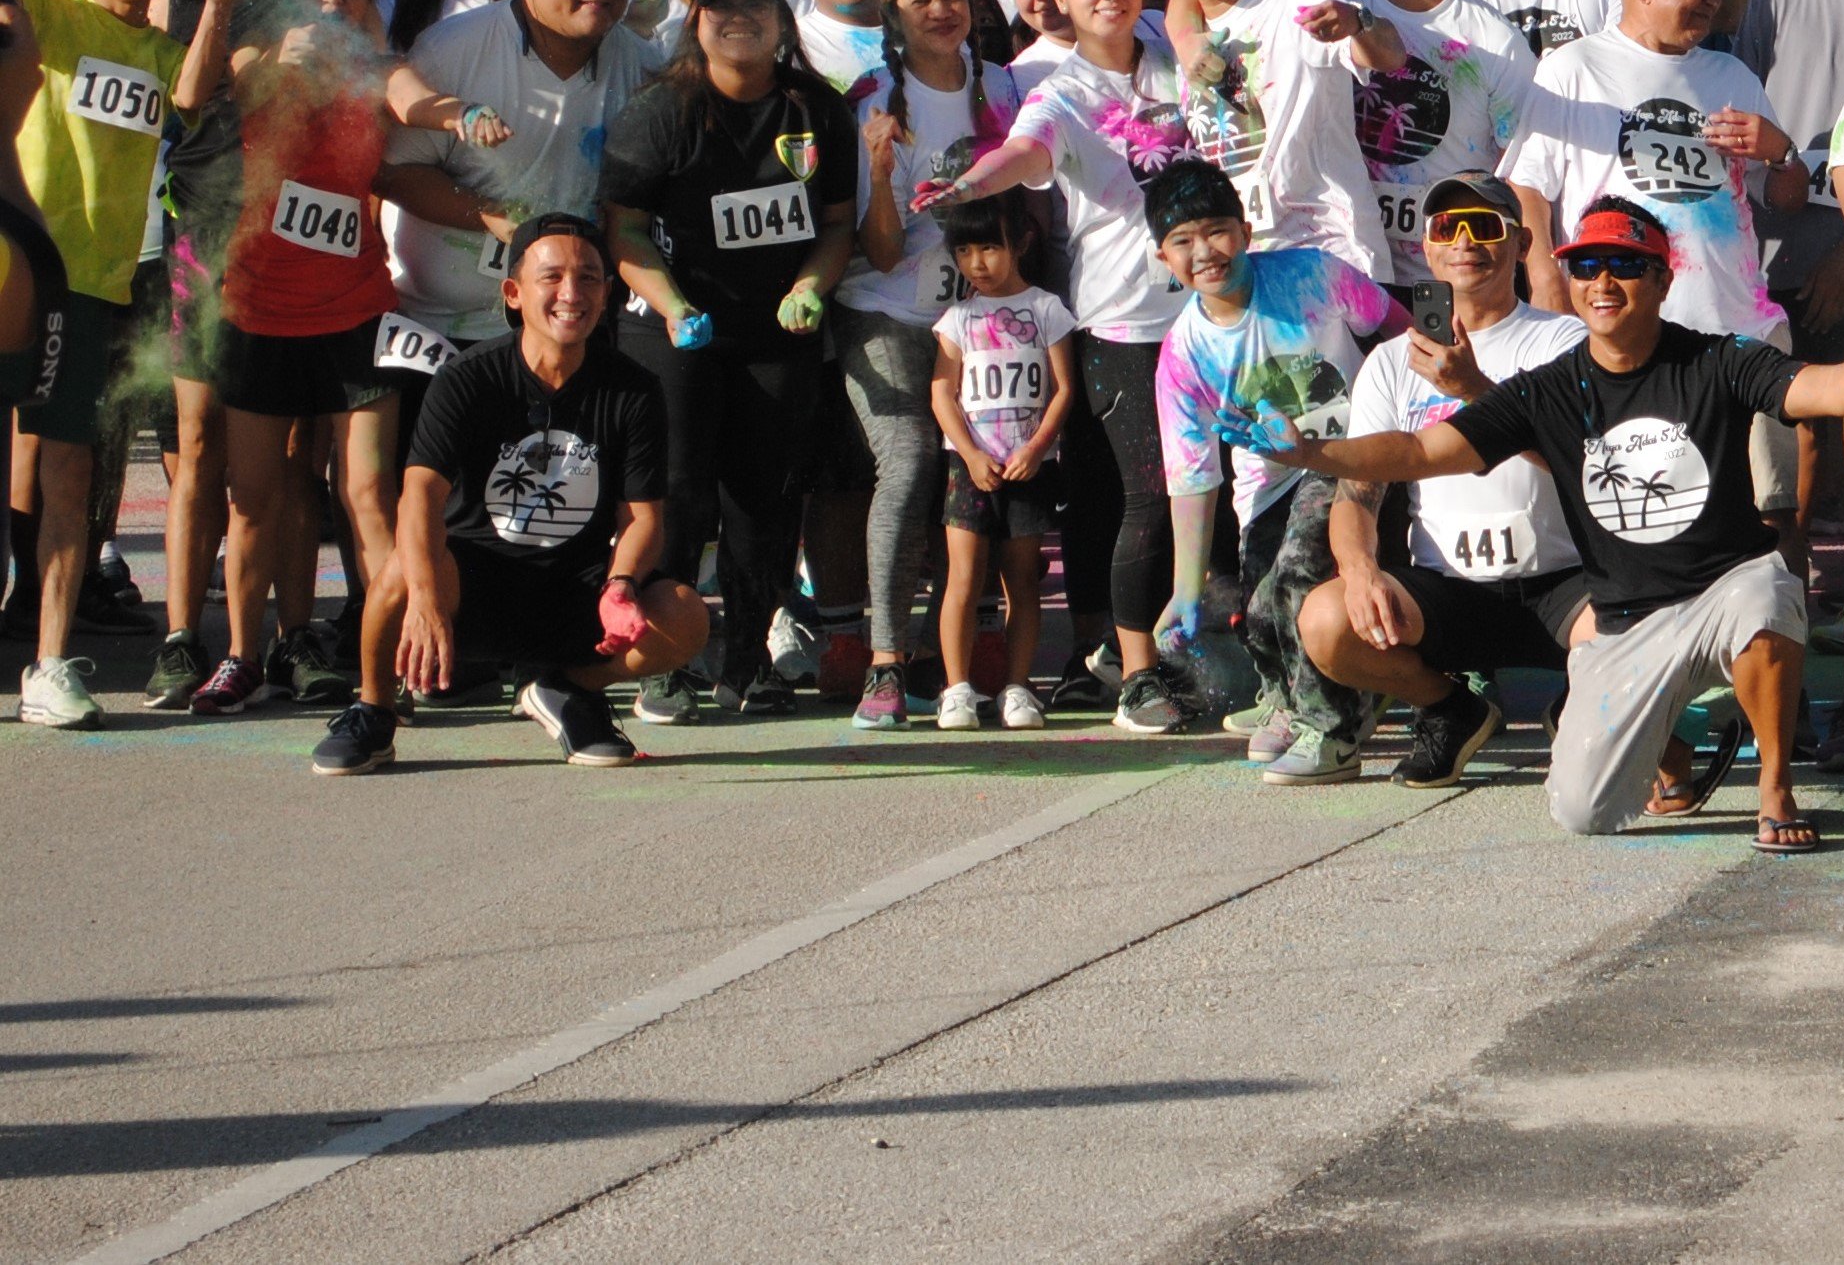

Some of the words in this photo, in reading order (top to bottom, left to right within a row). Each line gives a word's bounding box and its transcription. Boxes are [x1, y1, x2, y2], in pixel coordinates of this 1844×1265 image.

[1551, 31, 1574, 42] 2022
[78, 72, 161, 126] 1050
[1418, 91, 1440, 103] 2022
[1650, 142, 1711, 180] 242
[280, 196, 358, 247] 1048
[722, 195, 805, 241] 1044
[36, 312, 63, 398] SONY
[969, 362, 1041, 402] 1079
[1625, 432, 1658, 453] Adai
[1660, 422, 1691, 442] 5K
[1664, 446, 1687, 461] 2022
[1455, 526, 1518, 568] 441
